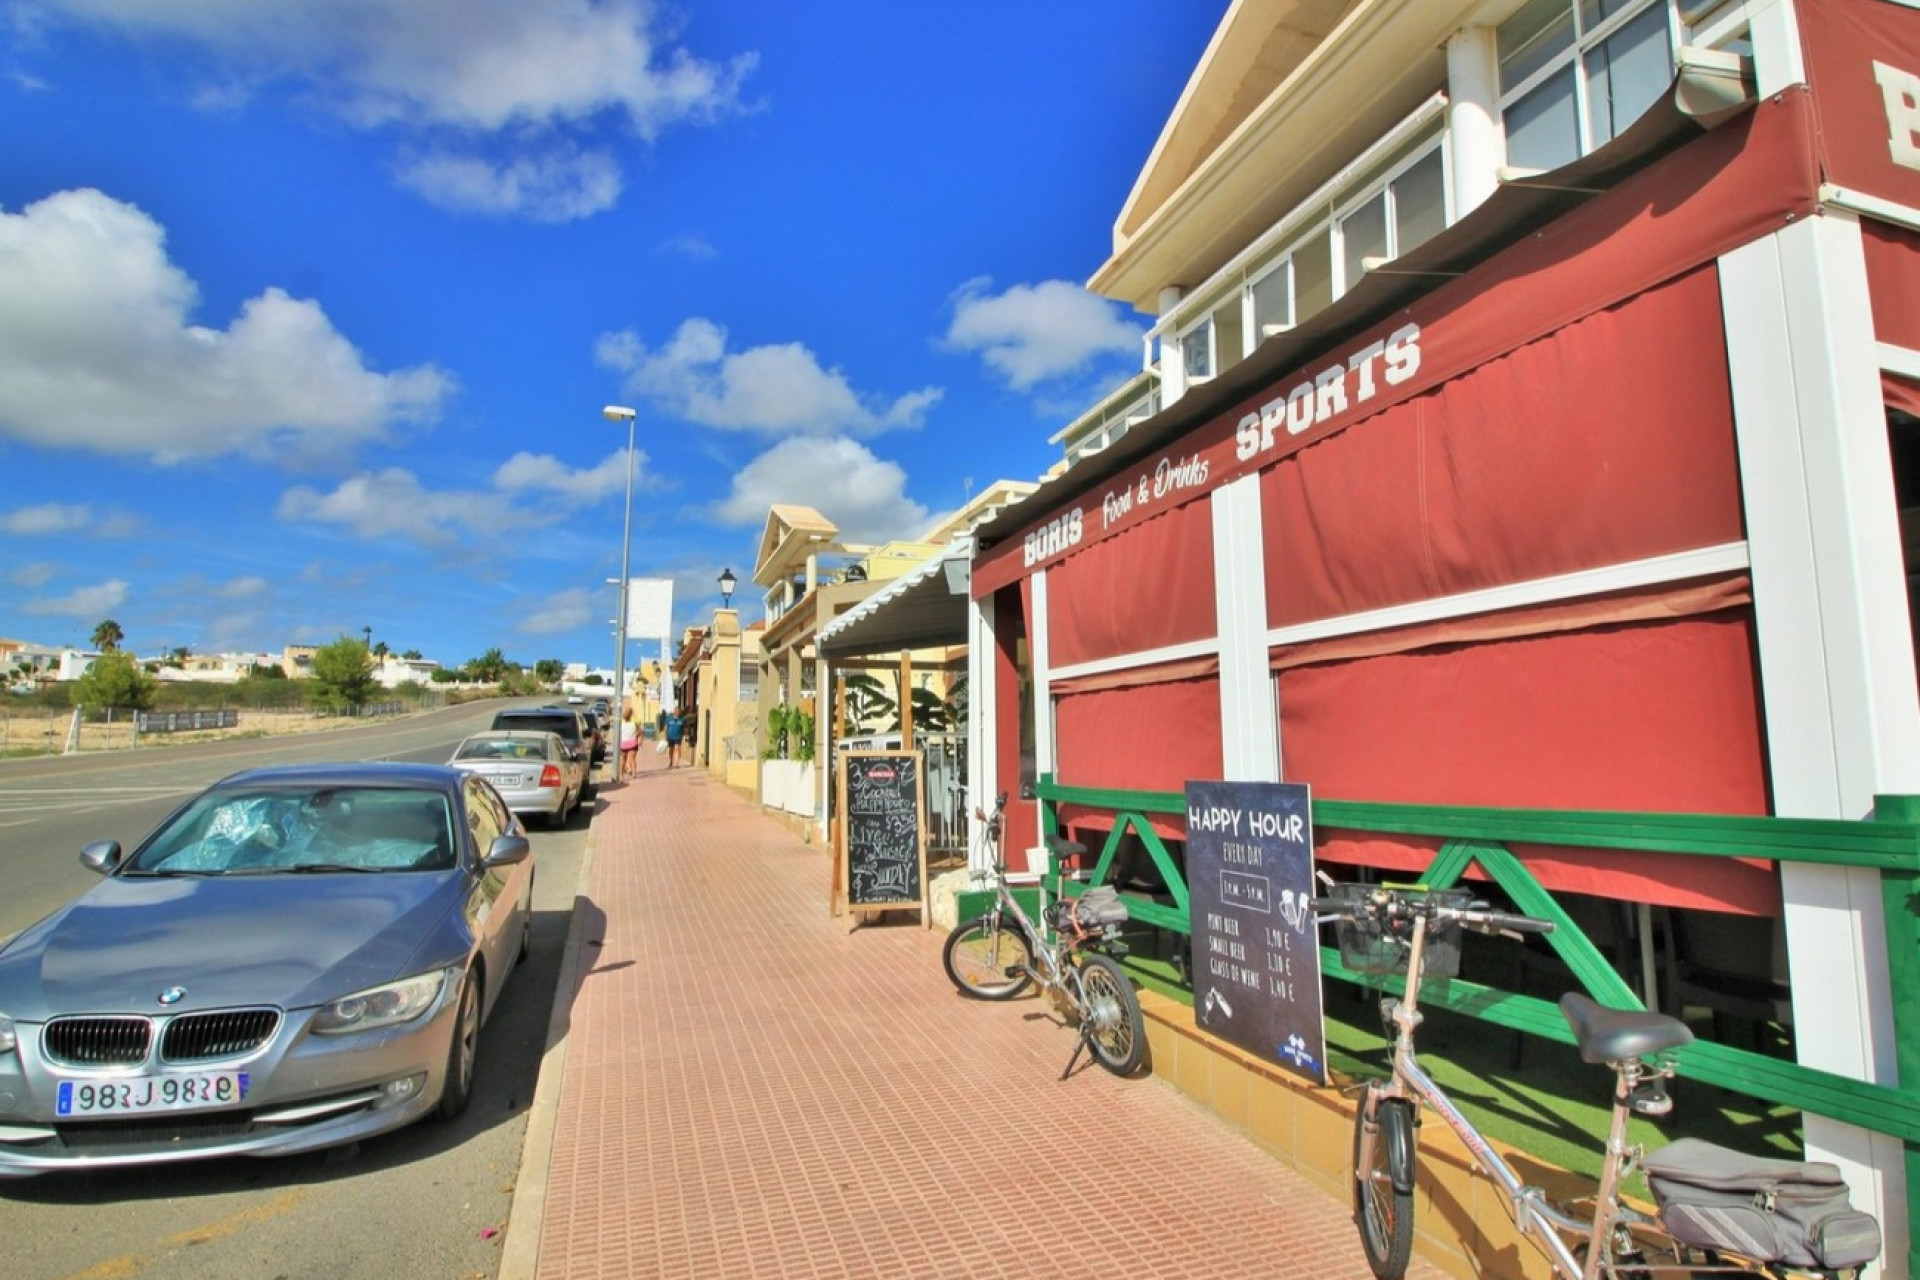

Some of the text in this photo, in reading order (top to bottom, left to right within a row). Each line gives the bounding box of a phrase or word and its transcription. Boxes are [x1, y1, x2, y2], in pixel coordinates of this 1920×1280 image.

[1235, 322, 1421, 462] SPORTS
[1102, 452, 1210, 530] Food & Drinks
[1024, 507, 1083, 568] BORIS
[1188, 805, 1304, 843] HAPPY HOUR
[1223, 842, 1262, 868] EVERY DAY
[1224, 917, 1239, 936] BEER
[1209, 935, 1245, 961] SMALL BEER
[1210, 957, 1260, 990] GLASS OF WINE
